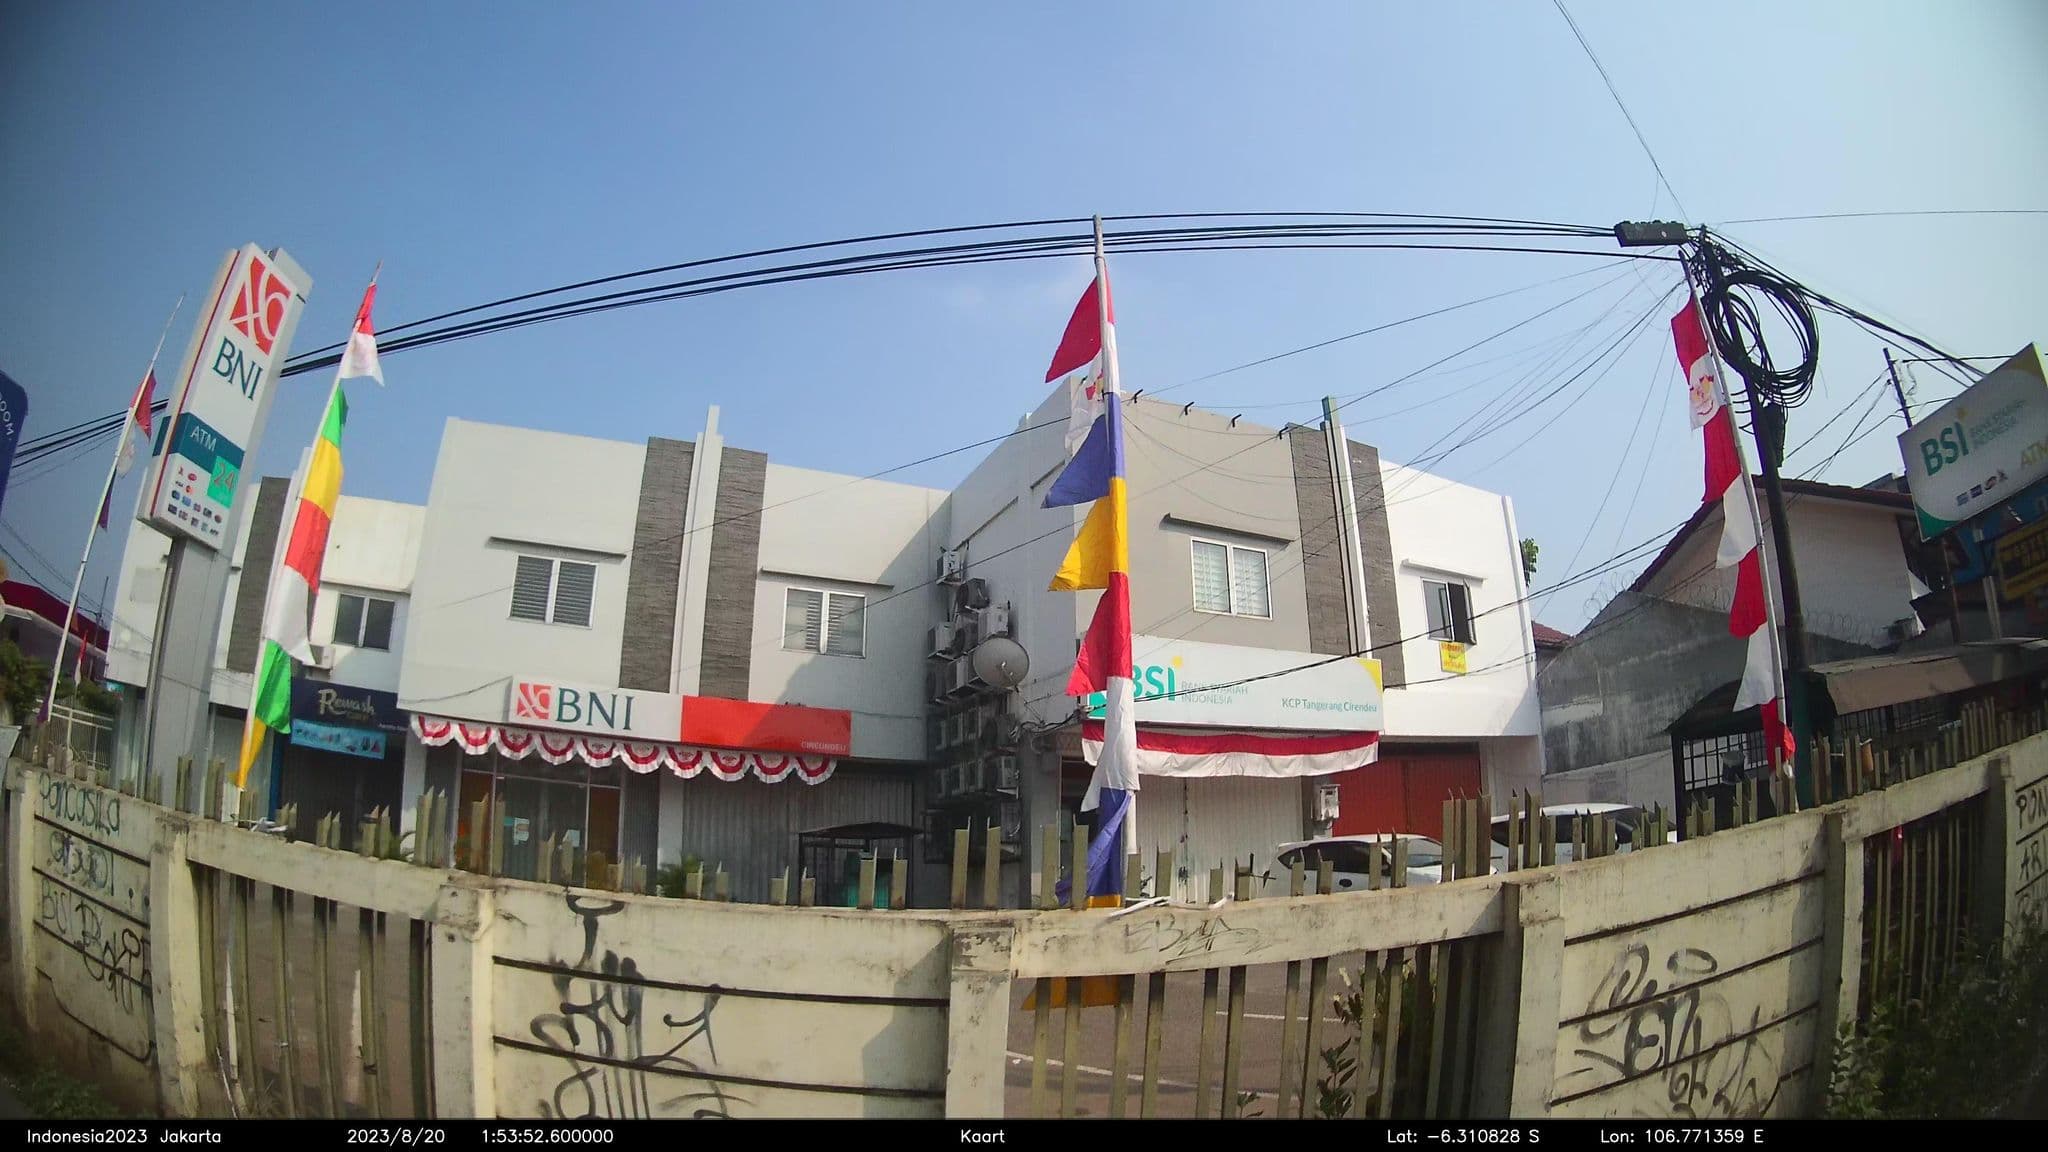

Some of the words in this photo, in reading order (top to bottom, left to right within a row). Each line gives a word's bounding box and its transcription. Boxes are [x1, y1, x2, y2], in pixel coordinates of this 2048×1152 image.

[212, 336, 263, 401] BNI
[190, 425, 217, 452] ATM
[1920, 422, 1969, 476] BSI
[212, 460, 236, 492] 24
[556, 687, 635, 730] BNI
[1282, 699, 1301, 709] KCP
[1301, 699, 1343, 713] Tangerang
[1343, 702, 1377, 713] Cirendeu
